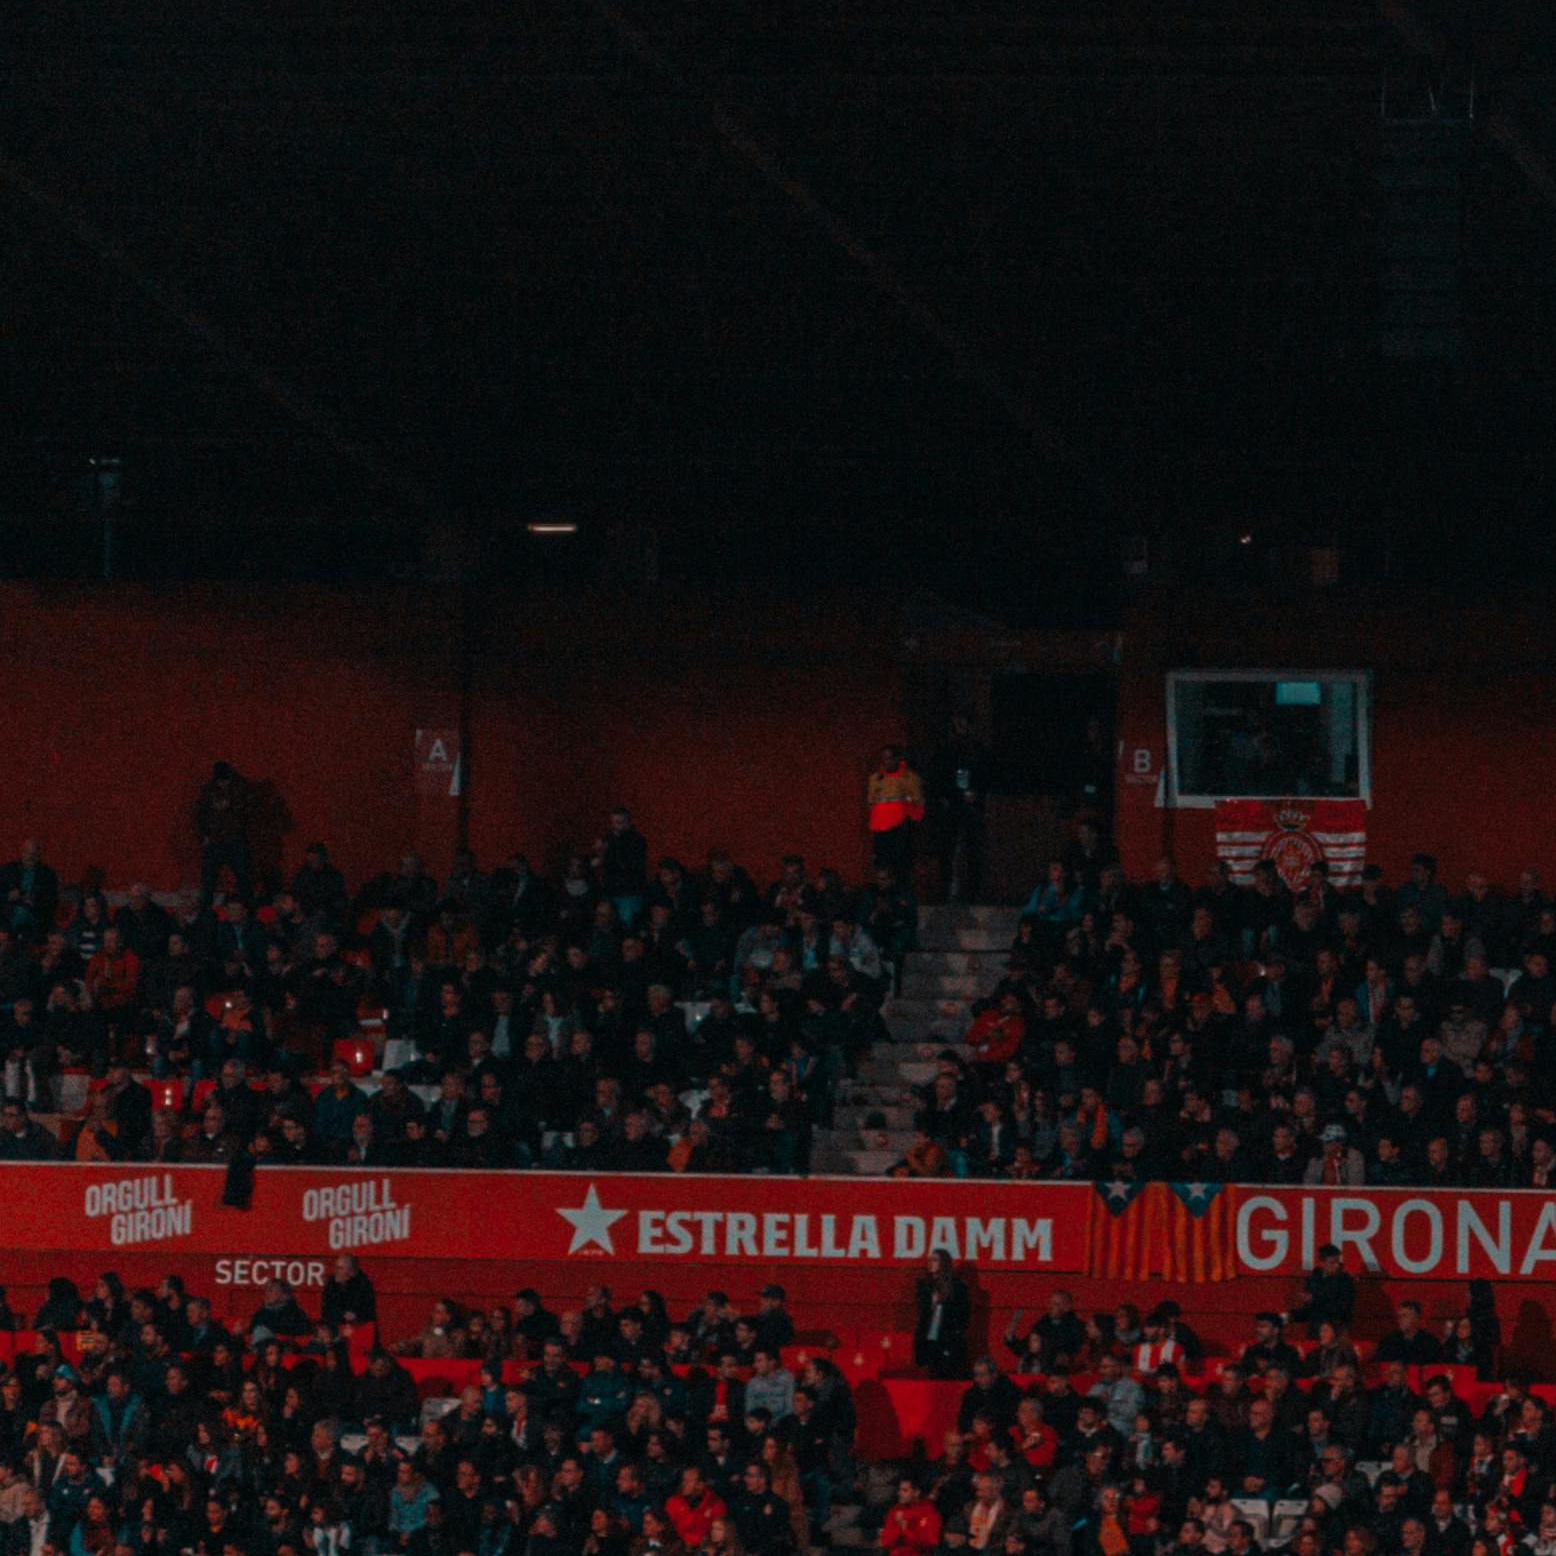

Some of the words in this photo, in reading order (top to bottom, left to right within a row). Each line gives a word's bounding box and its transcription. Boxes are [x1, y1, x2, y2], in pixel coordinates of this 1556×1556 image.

[84, 1173, 178, 1218] ORGULL
[301, 1177, 397, 1222] ORGULL
[637, 1209, 880, 1259] ESTRELLA
[893, 1214, 1054, 1262] DAMM
[214, 1259, 325, 1287] SECTOR
